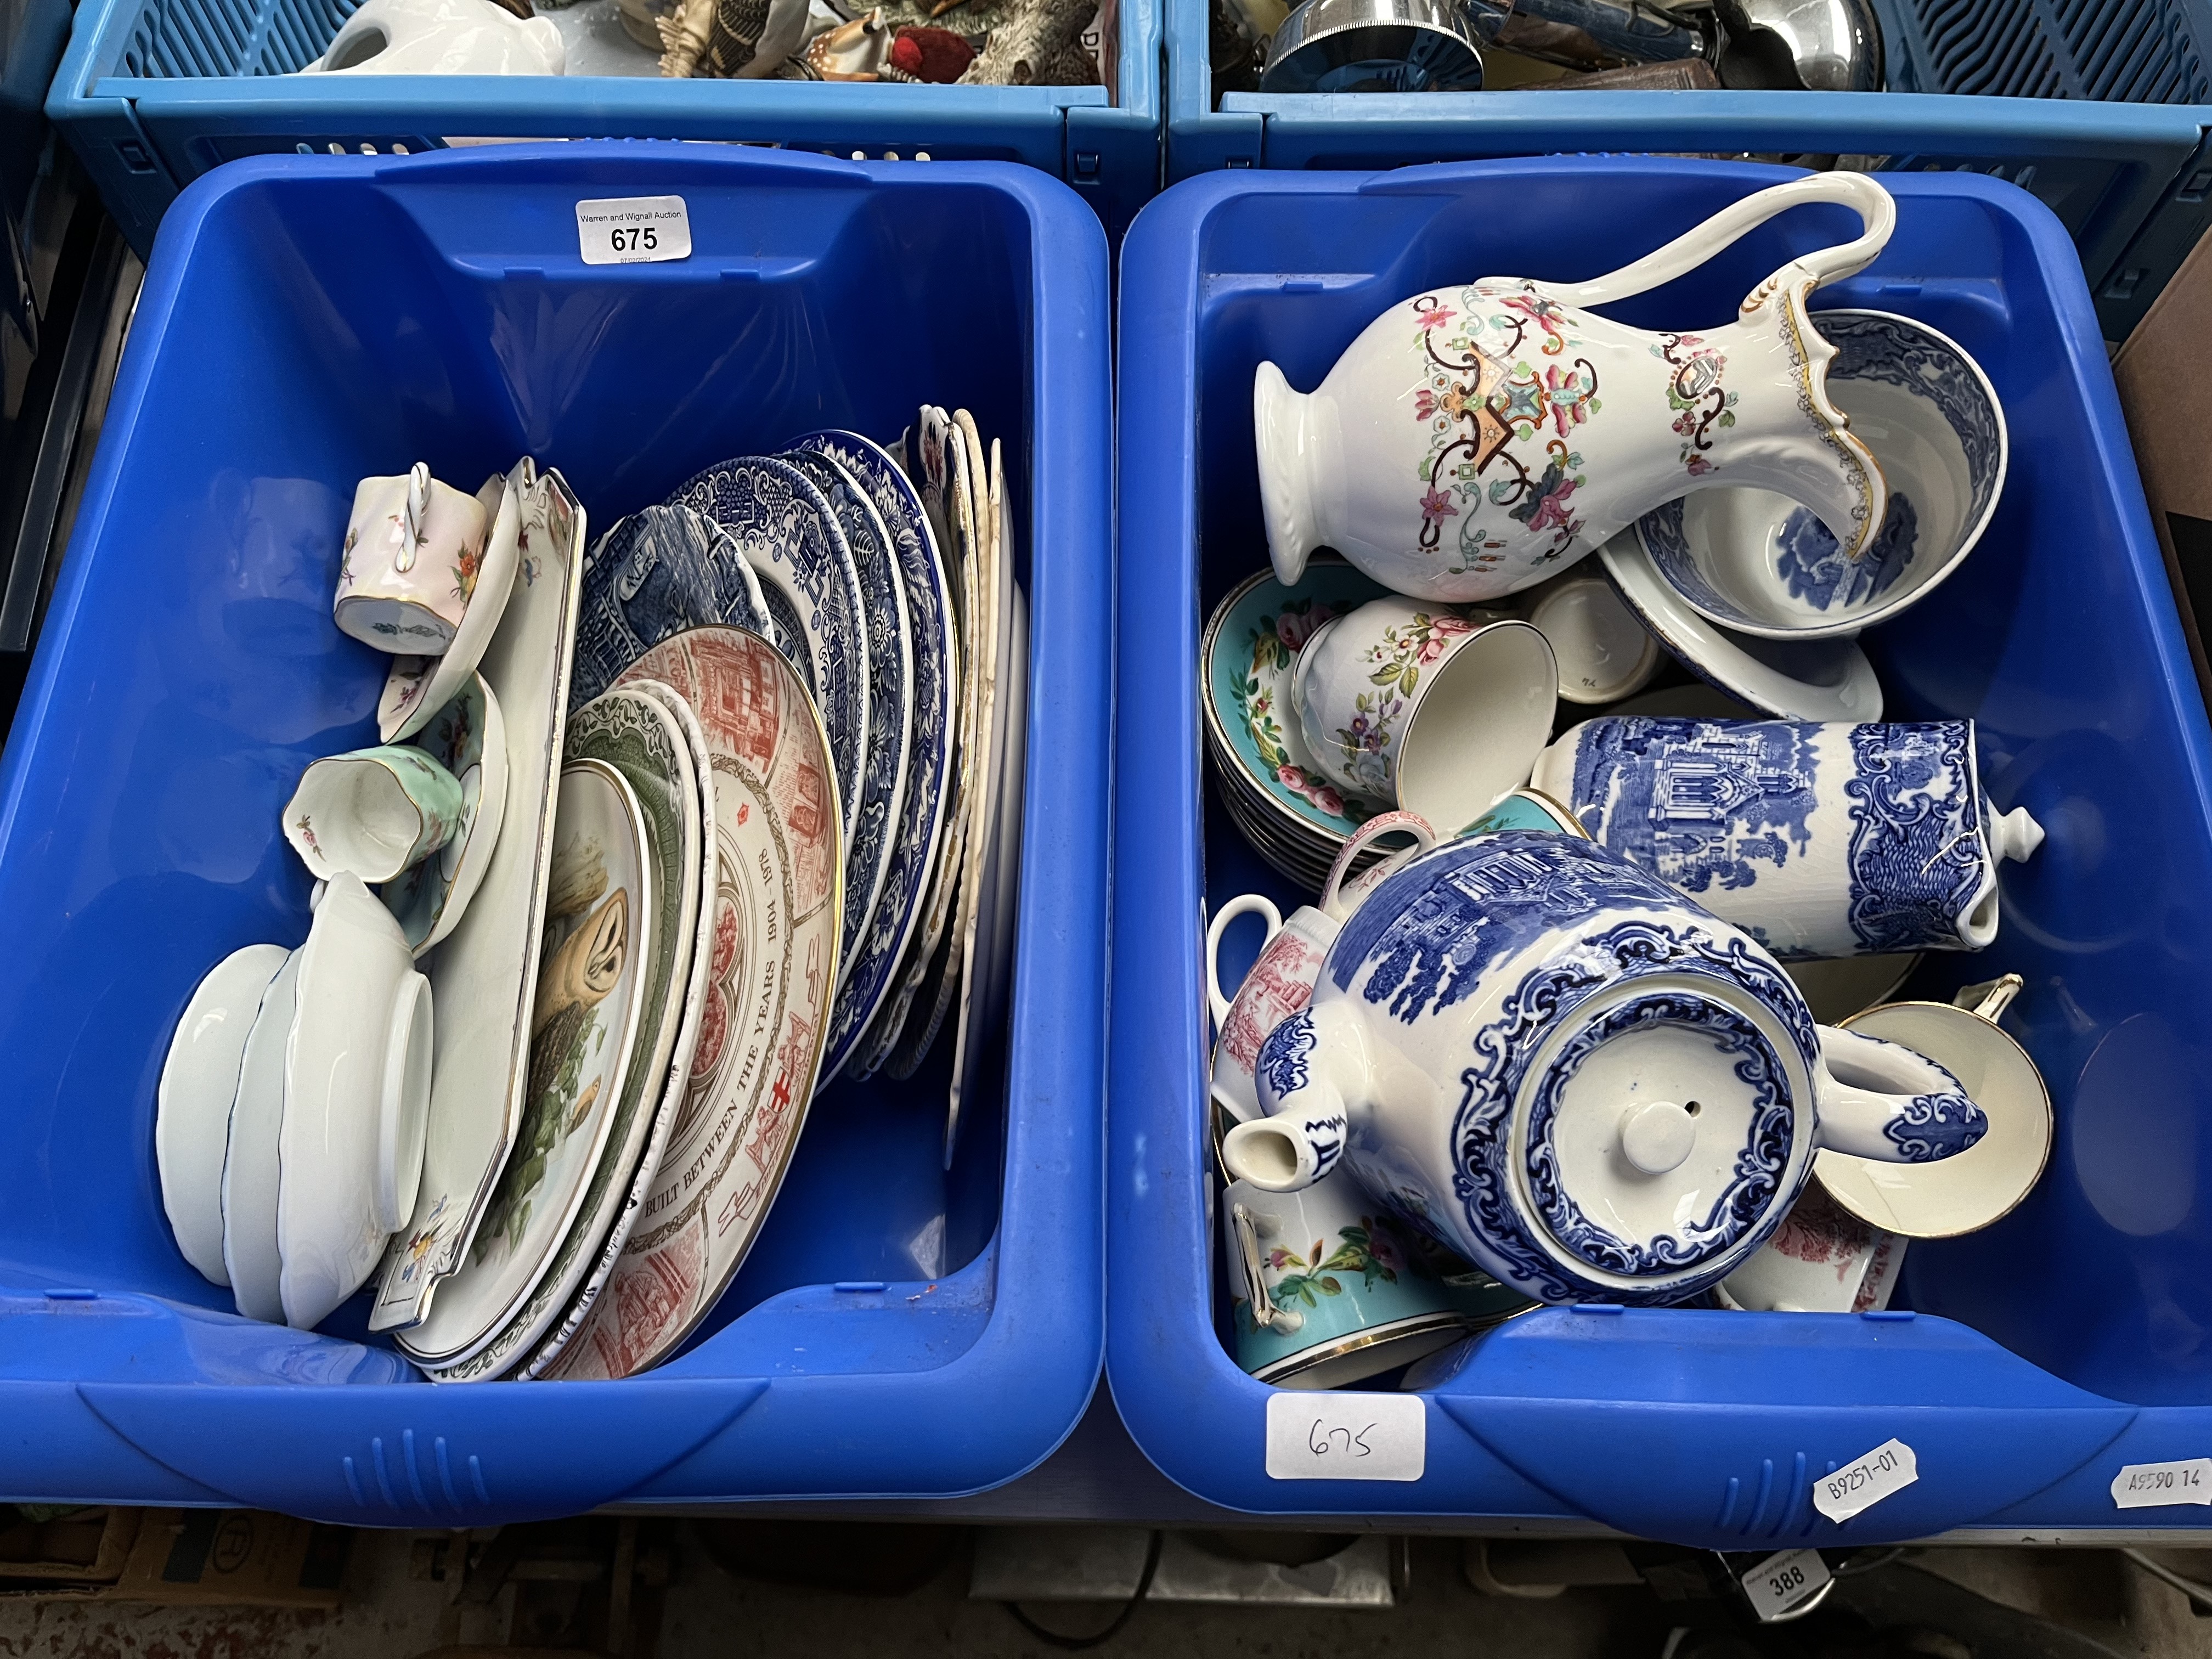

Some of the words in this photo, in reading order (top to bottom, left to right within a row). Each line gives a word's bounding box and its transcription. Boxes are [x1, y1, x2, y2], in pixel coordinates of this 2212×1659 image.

[625, 212, 653, 222] Wignall
[654, 211, 681, 219] Auction
[611, 227, 657, 251] 675
[758, 848, 772, 887] 1978
[767, 898, 776, 945] 1904
[754, 960, 775, 1036] YEARS
[737, 1045, 758, 1092] THE
[682, 1098, 737, 1191] BETWEEN
[645, 1182, 680, 1218] BUILT
[1309, 1418, 1378, 1457] 675
[1827, 1449, 1898, 1500] B9251-01
[1769, 1565, 1804, 1596] 388
